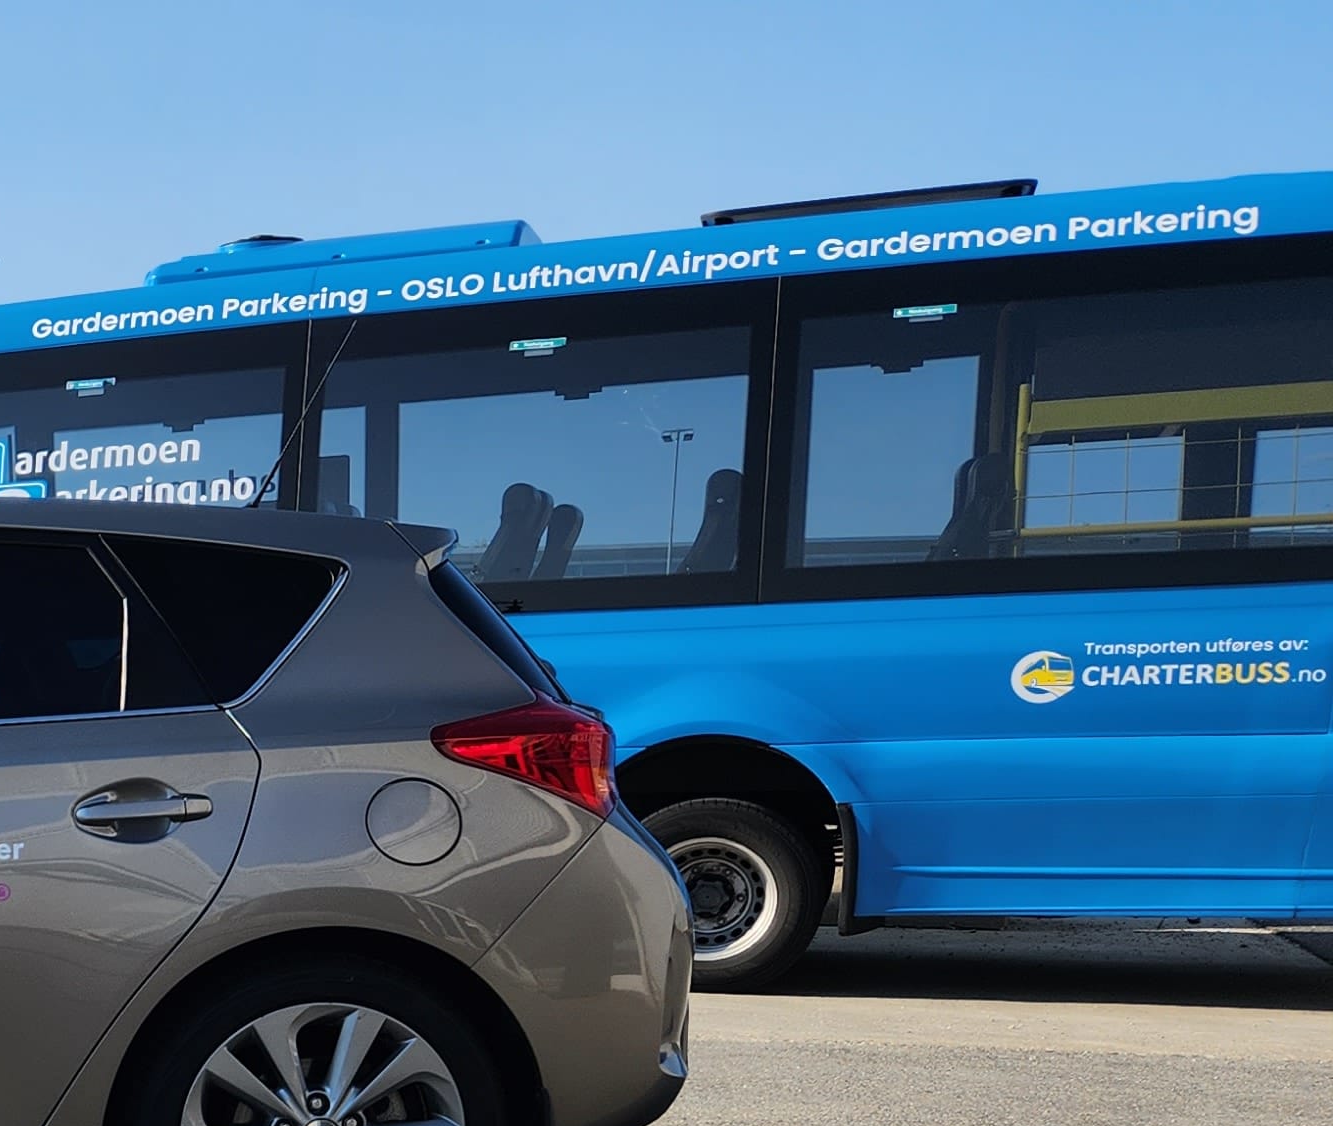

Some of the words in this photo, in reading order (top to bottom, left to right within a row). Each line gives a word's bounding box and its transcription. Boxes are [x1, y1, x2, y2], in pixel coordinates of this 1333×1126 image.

[31, 302, 215, 339] Gardermoen
[221, 287, 368, 314] Parkering
[400, 272, 485, 302] OSLO
[492, 243, 779, 293] Lufthavn/Airport
[816, 217, 1058, 263] Gardermoen
[1067, 204, 1260, 235] Parkering
[1084, 640, 1201, 657] Transporten
[1206, 637, 1274, 654] utføres
[1279, 637, 1310, 652] av:
[1081, 661, 1327, 688] CHARTERBUSS.no
